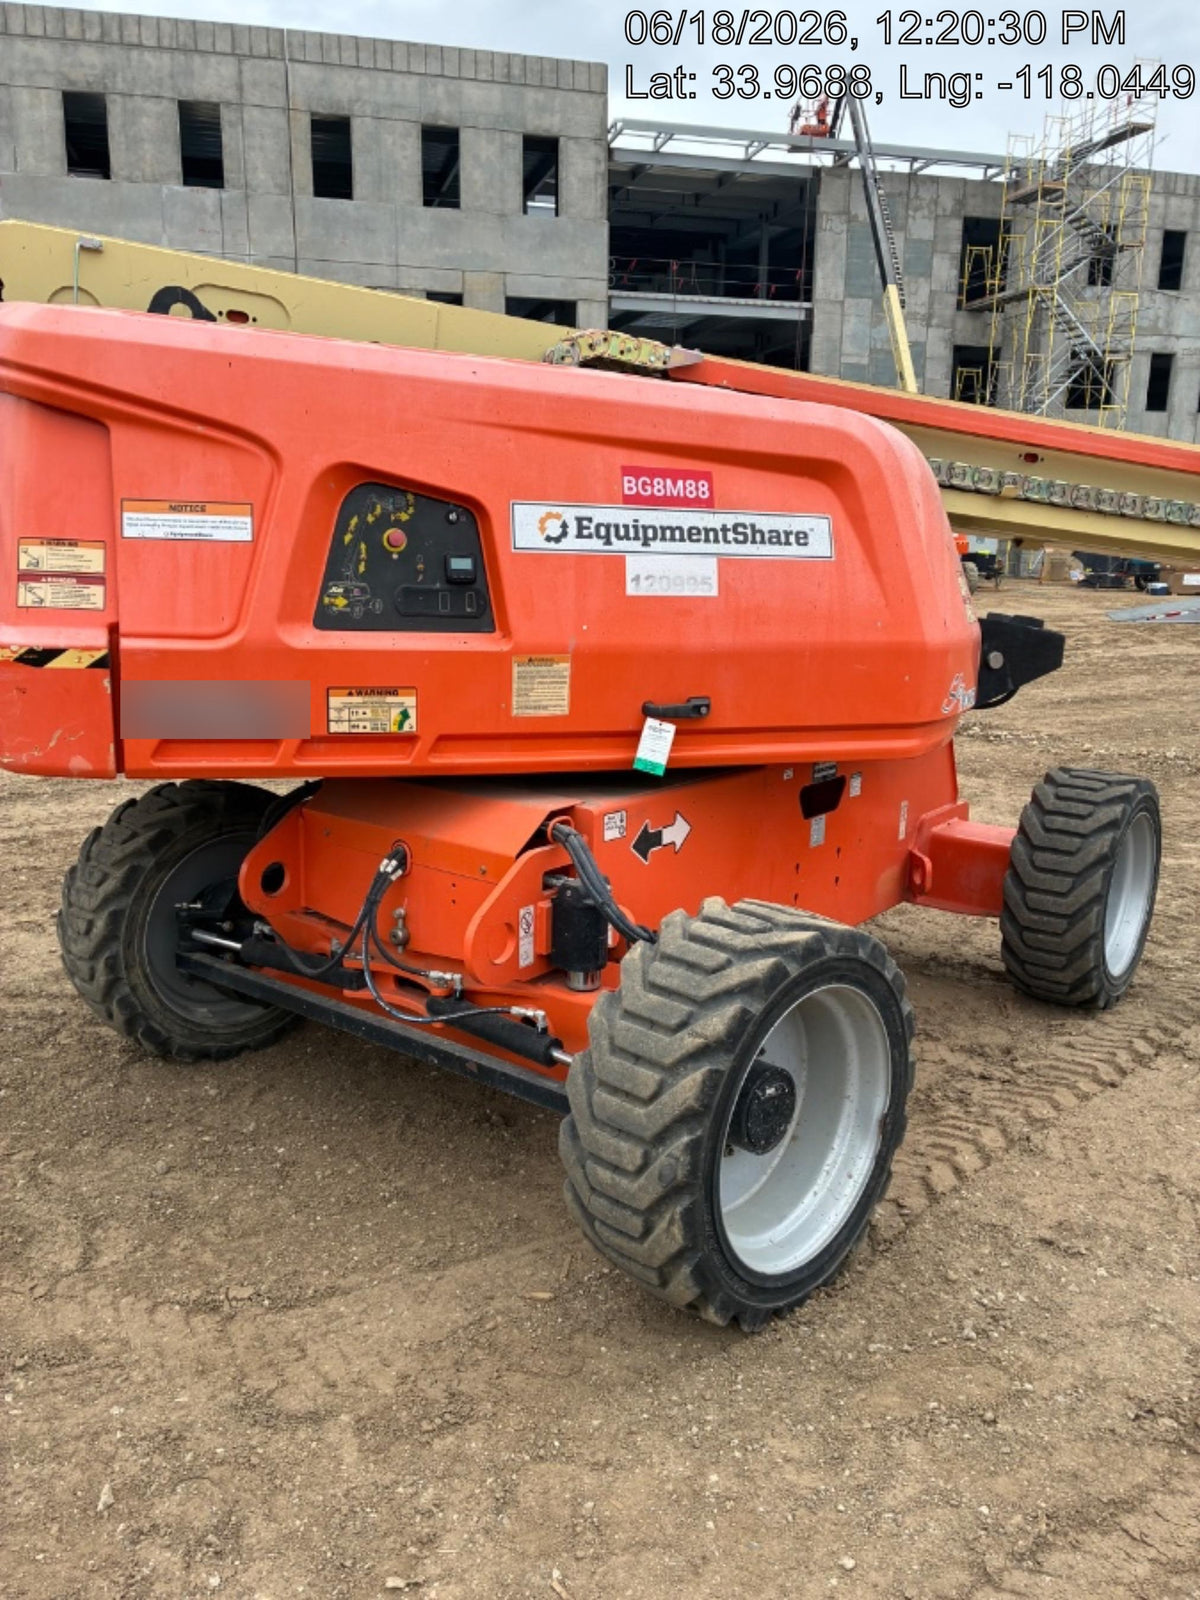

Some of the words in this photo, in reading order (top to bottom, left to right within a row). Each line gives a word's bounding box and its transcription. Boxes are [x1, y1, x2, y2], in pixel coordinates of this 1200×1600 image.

[622, 475, 711, 499] BG8M88
[574, 515, 810, 547] EquipmentShare
[355, 688, 399, 697] WARNING
